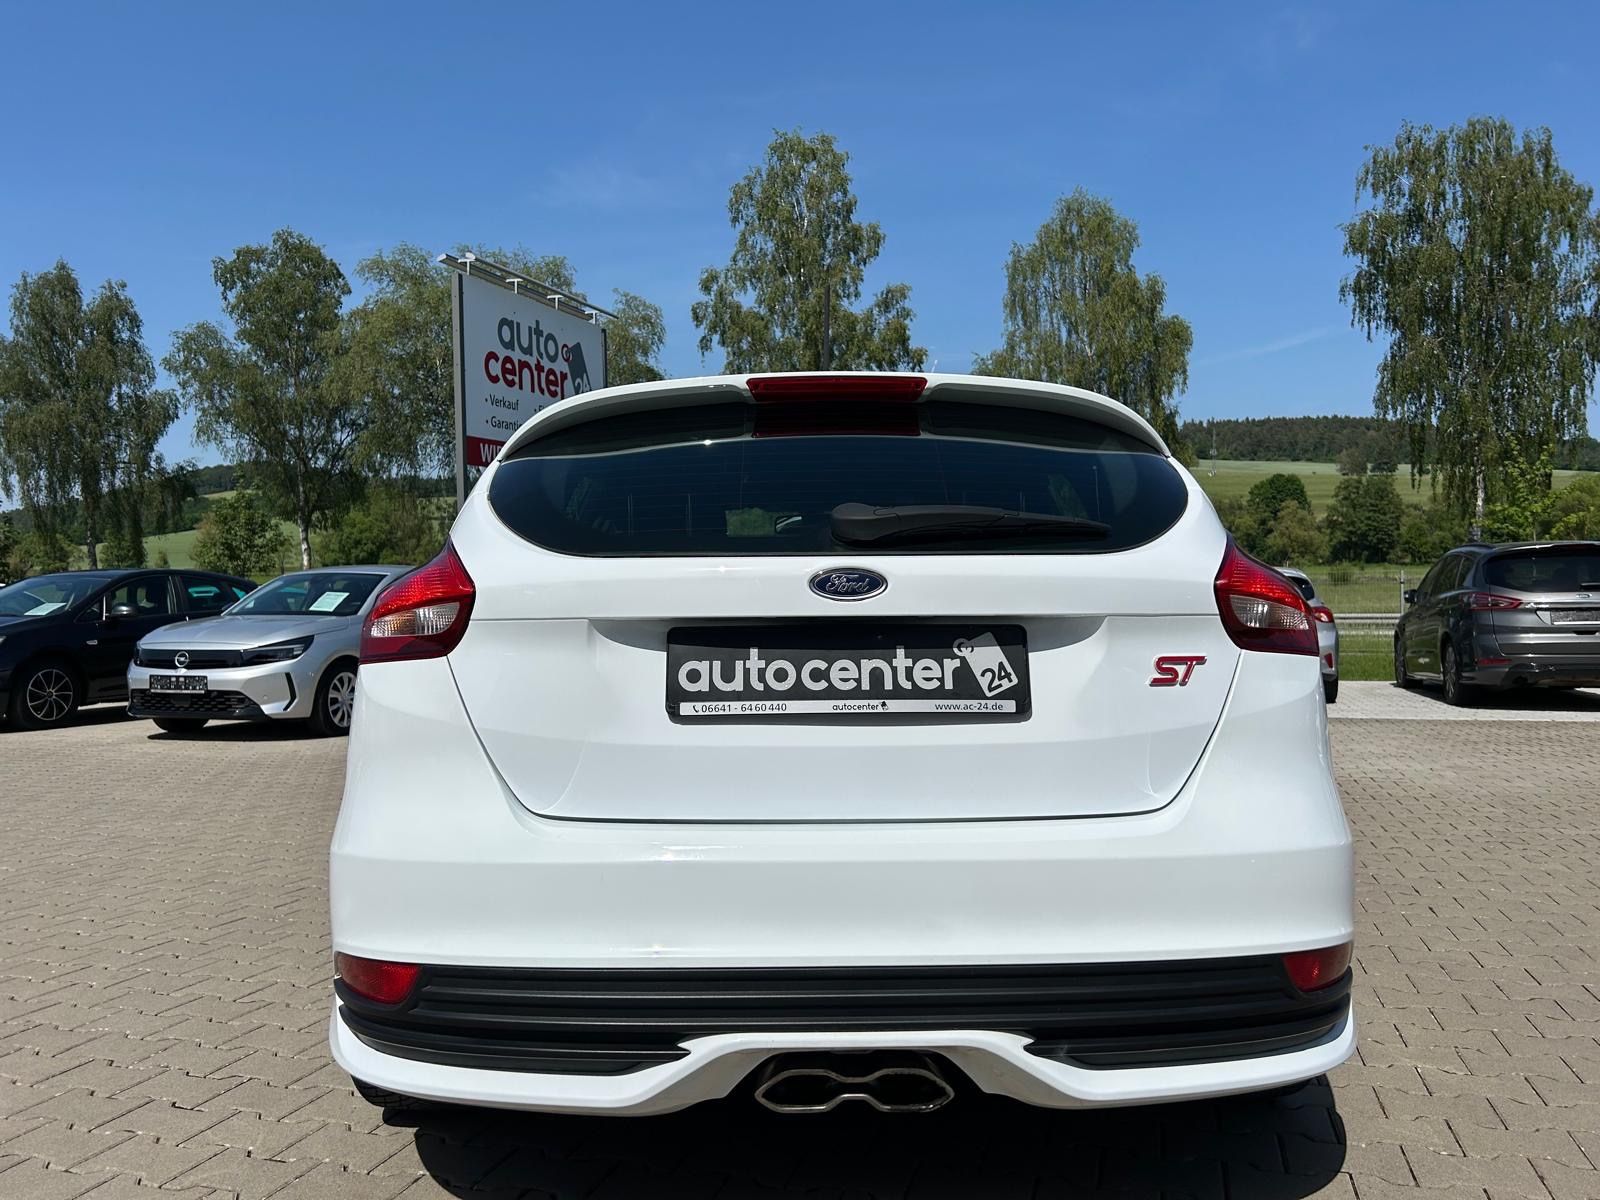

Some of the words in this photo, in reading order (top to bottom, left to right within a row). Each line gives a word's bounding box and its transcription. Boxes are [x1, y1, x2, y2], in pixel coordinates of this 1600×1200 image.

[497, 316, 559, 364] auto
[484, 351, 568, 400] center
[489, 393, 519, 411] Verkauf
[825, 574, 870, 593] Ford
[980, 661, 1014, 693] 24
[1149, 656, 1207, 687] ST
[701, 704, 731, 713] 06641
[832, 702, 879, 711] autocenter
[935, 702, 1003, 711] www.ac-24.de
